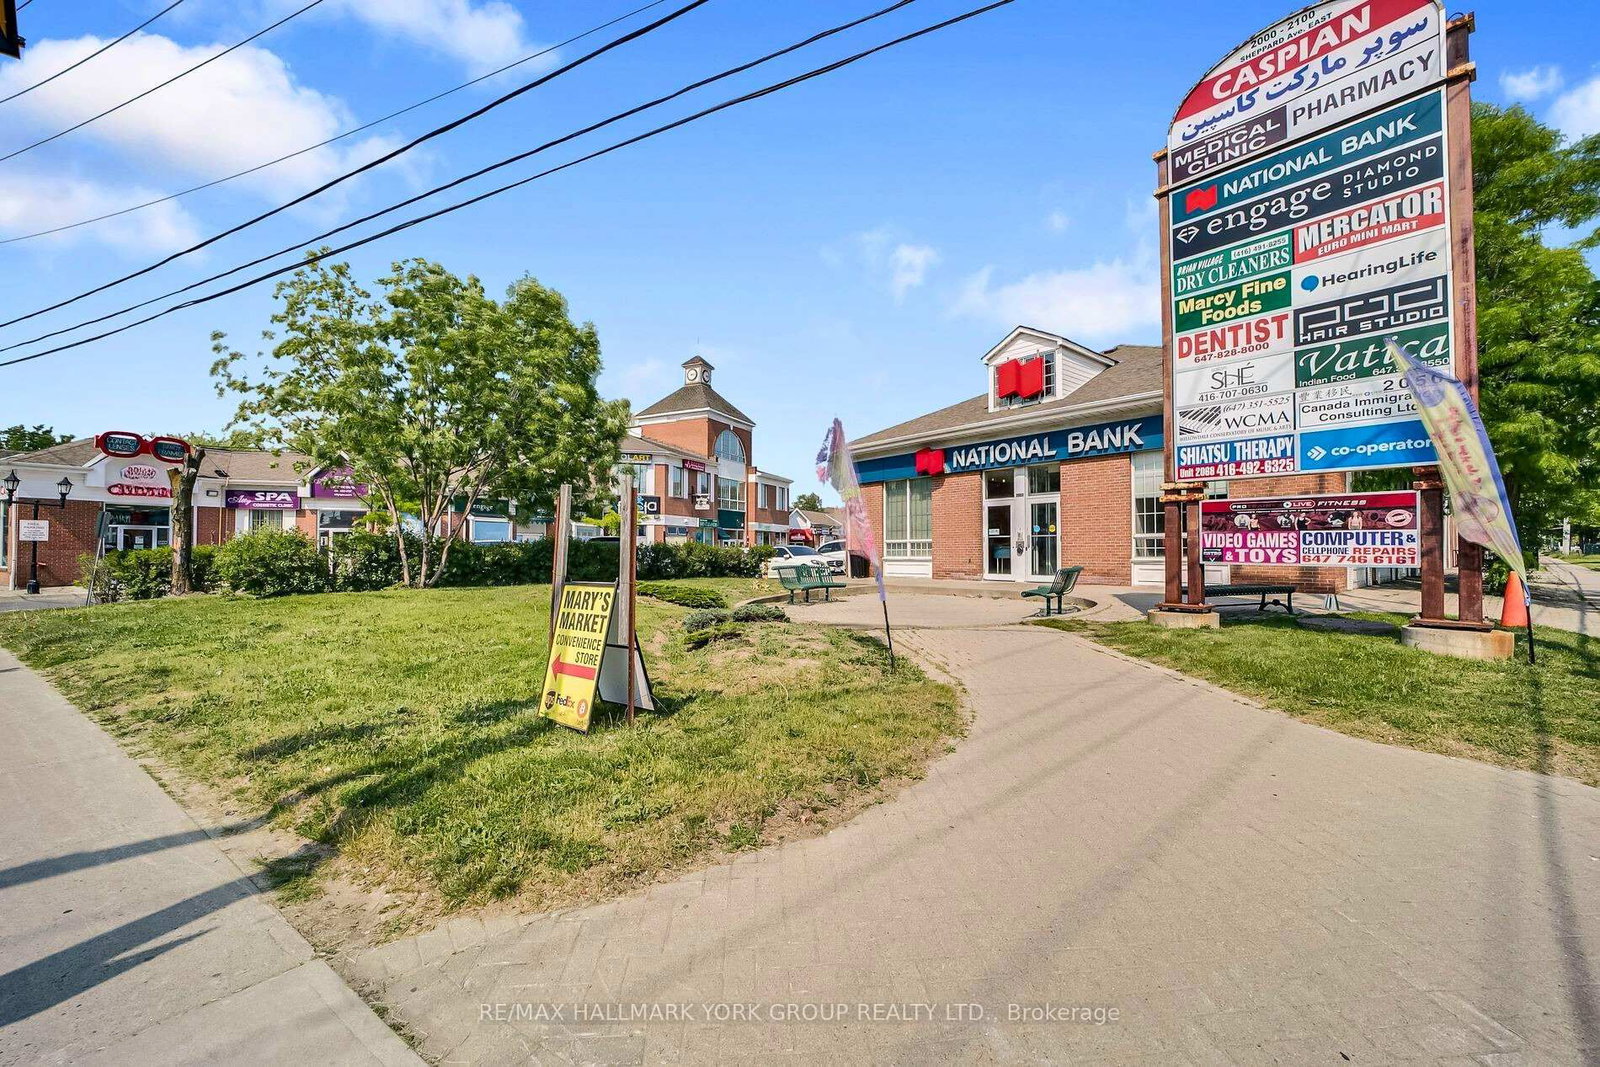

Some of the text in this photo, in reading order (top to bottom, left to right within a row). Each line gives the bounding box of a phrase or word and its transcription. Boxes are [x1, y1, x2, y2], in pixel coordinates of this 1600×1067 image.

[1240, 37, 1284, 62] SHEPPARD
[1308, 12, 1332, 29] EAST
[1250, 30, 1277, 49] 2000
[1287, 10, 1315, 30] 2100
[1212, 5, 1372, 100] CASPIAN
[1182, 16, 1428, 142] سوپر مارکت کاسپین
[1292, 49, 1434, 127] PHARMACY
[1175, 119, 1280, 168] MEDICAL
[1187, 136, 1266, 175] CLINIC
[1223, 112, 1418, 198] NATIONAL BANK
[1343, 145, 1437, 185] DIAMOND
[1343, 167, 1420, 198] STUDIO
[1207, 182, 1332, 235] engage
[1298, 186, 1443, 254] MERCATOR
[1318, 220, 1418, 256] EURO MINI MART
[1177, 247, 1290, 293] DRY CLEANERS
[1197, 254, 1224, 269] VILLAGE
[1322, 250, 1437, 287] HearingLife
[1179, 277, 1287, 314] Marcy Fine
[1202, 300, 1262, 325] Foods
[1300, 306, 1444, 343] HAIR STUDIO
[1178, 313, 1289, 359] DENTIST
[1194, 342, 1270, 363] 647-828-8000
[1300, 372, 1356, 387] Indian Food
[1199, 385, 1268, 402] 416-707-0630
[1302, 401, 1350, 413] Canada
[1355, 392, 1412, 406] Immigra
[1225, 411, 1289, 430] WCMA
[1320, 406, 1392, 421] Consulting
[953, 422, 1144, 469] NATIONAL BANK
[1180, 437, 1293, 466] SHIATSU THERAPY
[1331, 438, 1433, 456] co-operator
[1180, 467, 1194, 477] Unit
[255, 492, 293, 501] SPA
[1203, 532, 1297, 548] VIDEO GAMES
[1302, 531, 1416, 546] COMPUTER &
[1302, 547, 1416, 555] CELLPHONE REPAIRS
[1225, 551, 1233, 561] &
[1235, 548, 1297, 563] TOYS
[1302, 555, 1416, 564] 647 746 6161
[563, 590, 611, 613] MARY'S
[559, 612, 607, 634] MARKET
[555, 633, 602, 651] CONVENIENCE
[575, 651, 599, 666] STORE
[556, 693, 575, 708] FedEx
